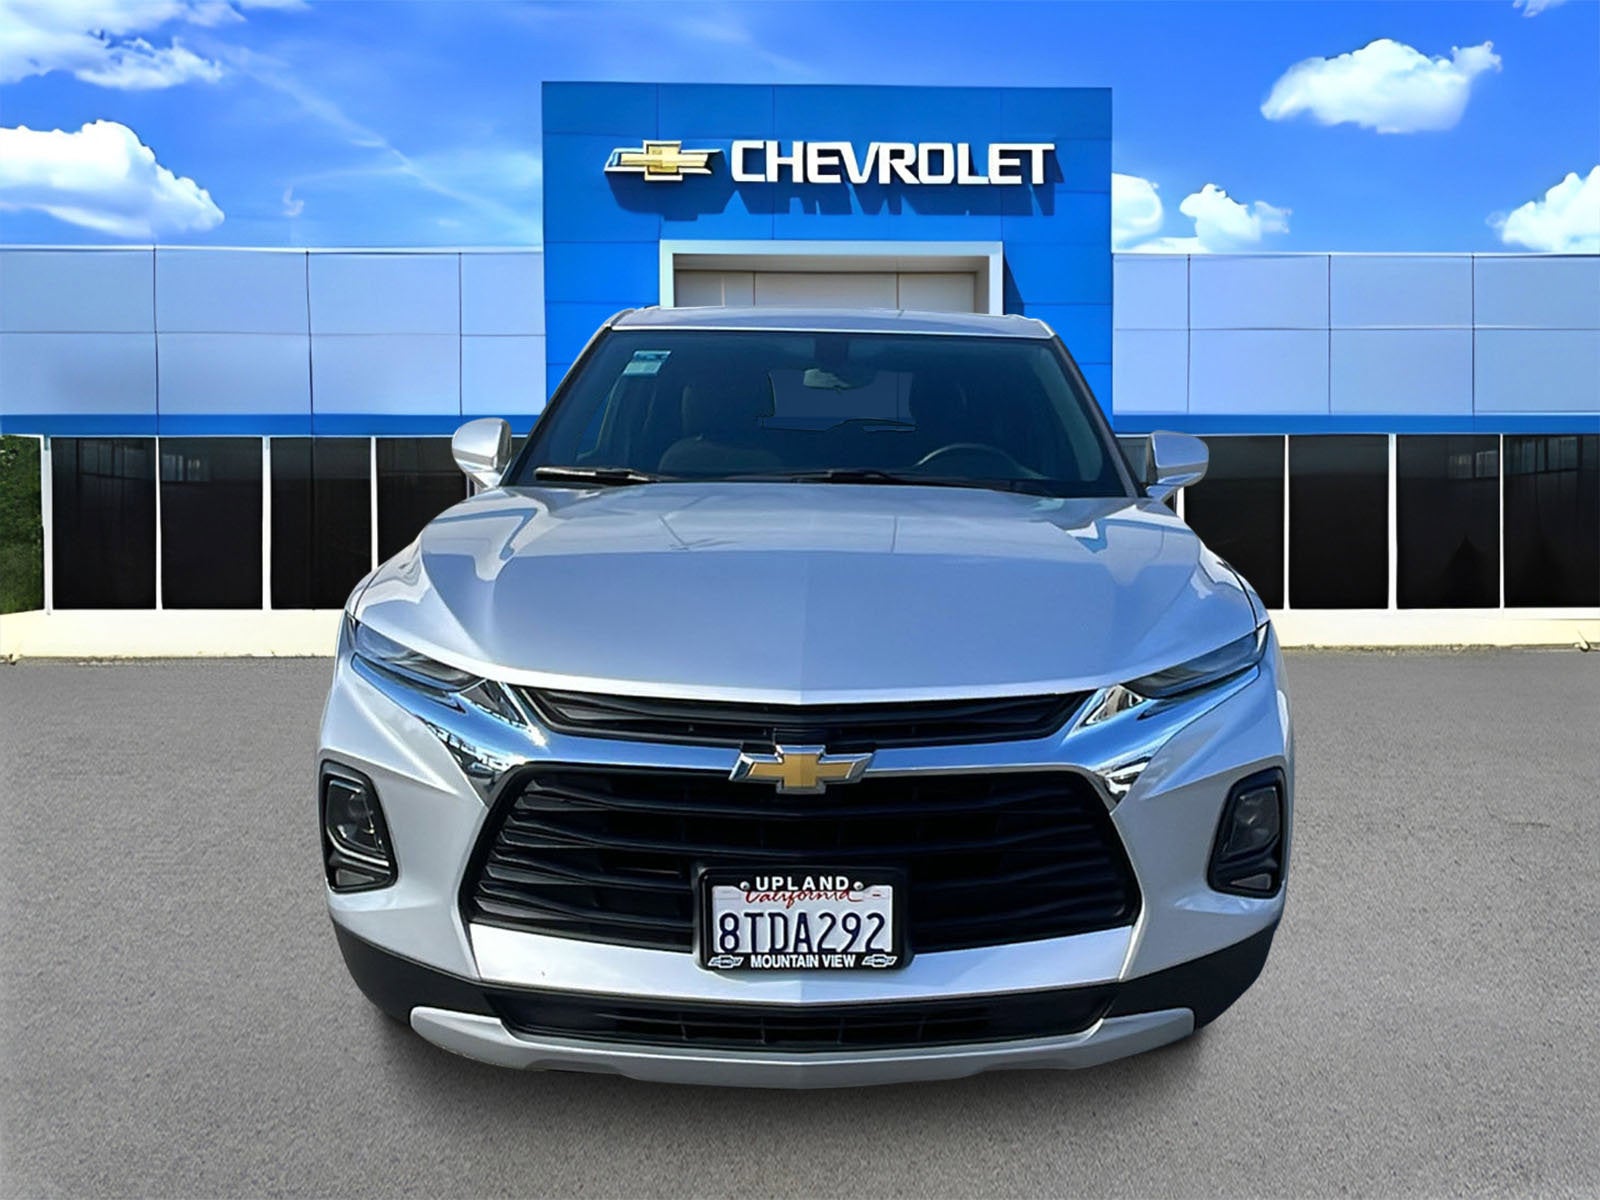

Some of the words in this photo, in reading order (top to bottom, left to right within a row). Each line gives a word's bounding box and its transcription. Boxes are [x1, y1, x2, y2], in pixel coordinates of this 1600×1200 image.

[730, 139, 1056, 185] CHEVROLET
[755, 876, 850, 891] UPLAND
[718, 912, 886, 954] 8TDA292
[750, 954, 819, 969] MOUNTAIN
[824, 954, 856, 969] VIEW
